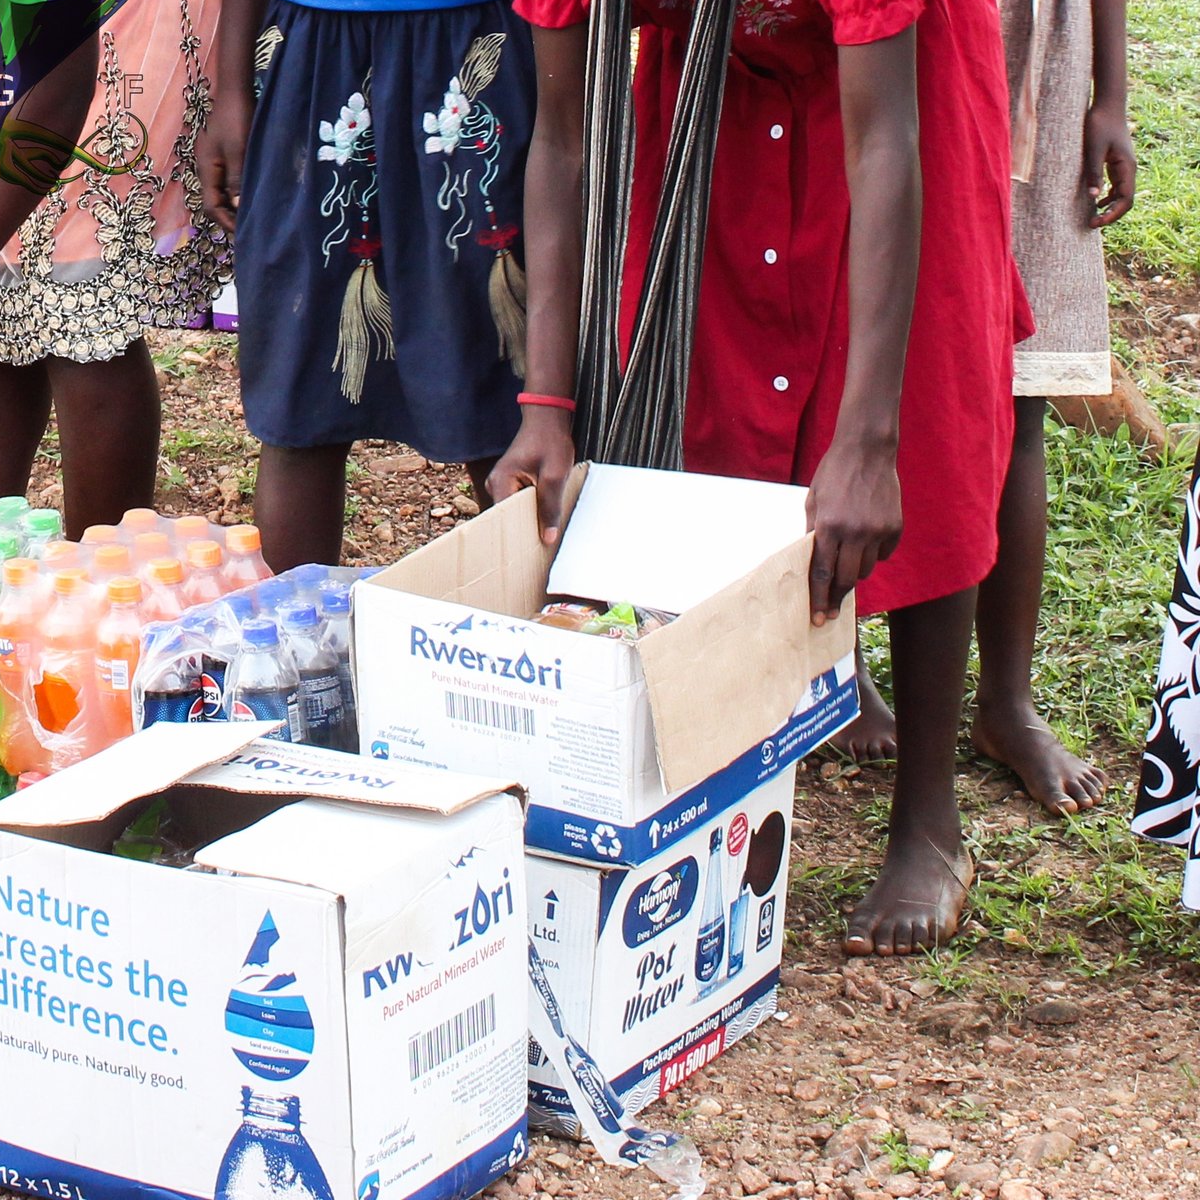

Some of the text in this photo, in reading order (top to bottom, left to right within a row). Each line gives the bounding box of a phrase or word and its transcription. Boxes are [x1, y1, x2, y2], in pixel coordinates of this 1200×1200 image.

[410, 625, 562, 690] Rwenzori
[431, 671, 559, 708] Pure Natural Mineral Water
[222, 754, 396, 789] Rwenzori
[563, 830, 588, 843] recycle
[564, 823, 587, 835] please
[661, 797, 708, 839] 24 x 500 ml
[638, 878, 682, 916] Harmony
[533, 923, 561, 943] Ltd.
[664, 909, 682, 926] Natural
[125, 959, 188, 1007] the
[383, 937, 506, 1021] Pure Natural Mineral Water
[636, 942, 677, 991] Pot
[261, 1011, 276, 1021] Loam
[622, 974, 685, 1035] Water
[249, 1041, 290, 1055] Sand and Gravel
[262, 1028, 275, 1037] Clay
[642, 997, 745, 1075] Packaged Drinking Water
[52, 1048, 83, 1067] pure.
[85, 1055, 147, 1084] Naturally
[150, 1073, 188, 1090] good.
[249, 1059, 291, 1075] Confined Aquifer
[664, 1033, 721, 1092] 24 x 500 ml
[579, 1069, 609, 1119] Harmony
[0, 1166, 22, 1188] 12
[24, 1177, 38, 1192] x
[42, 1178, 72, 1199] 1.5
